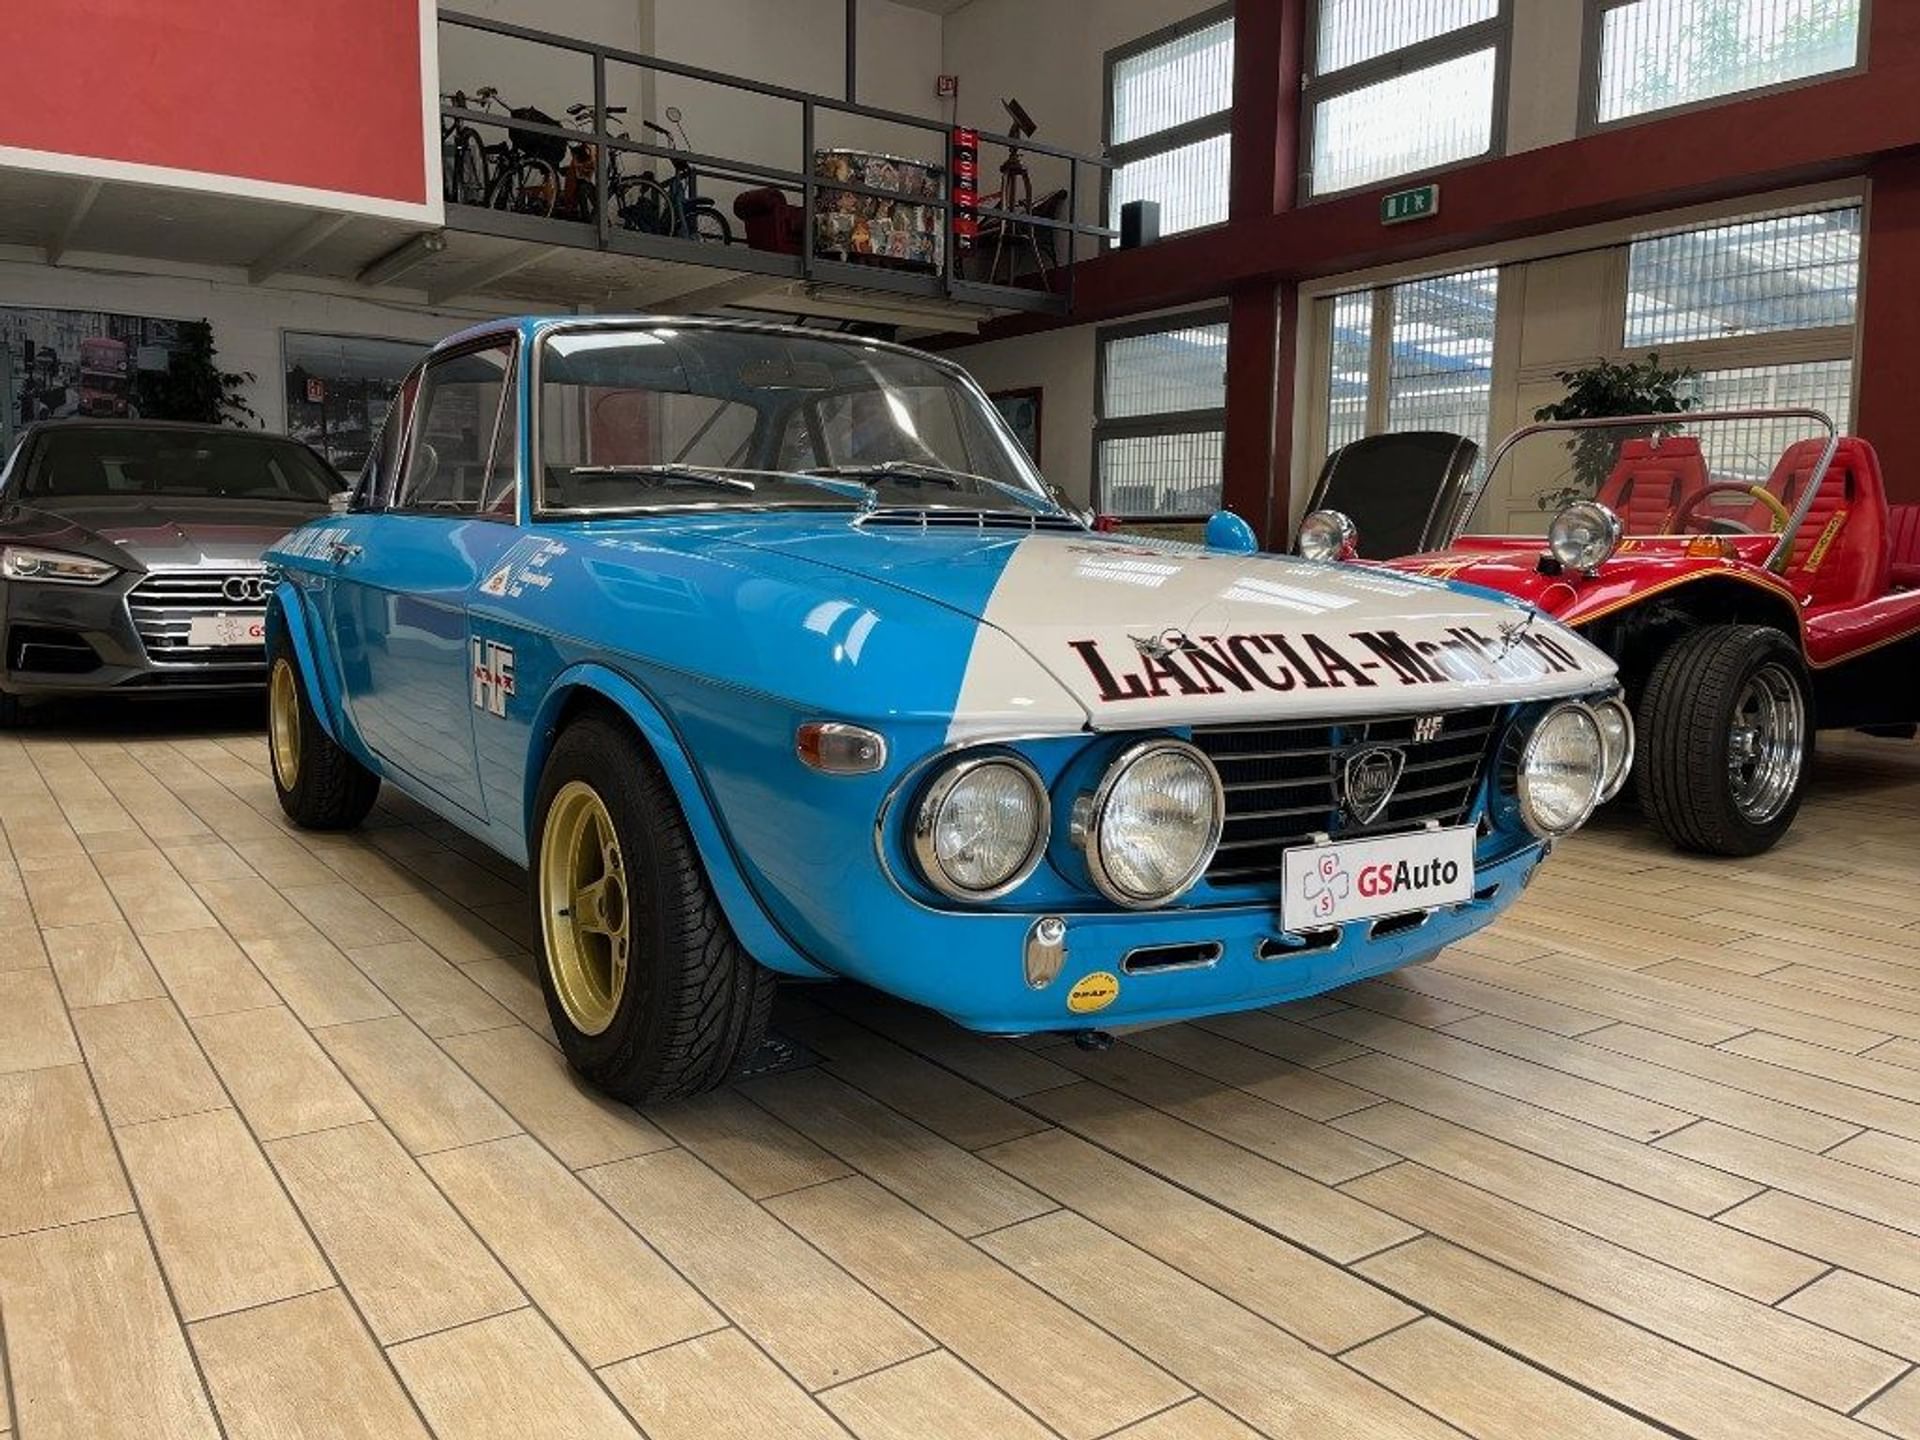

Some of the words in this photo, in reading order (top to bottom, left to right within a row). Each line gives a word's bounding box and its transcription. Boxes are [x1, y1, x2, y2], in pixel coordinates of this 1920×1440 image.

[470, 635, 516, 718] HF
[1414, 716, 1443, 741] HF
[1323, 861, 1332, 875] G
[1357, 857, 1458, 898] GSAuto
[1321, 896, 1329, 911] S
